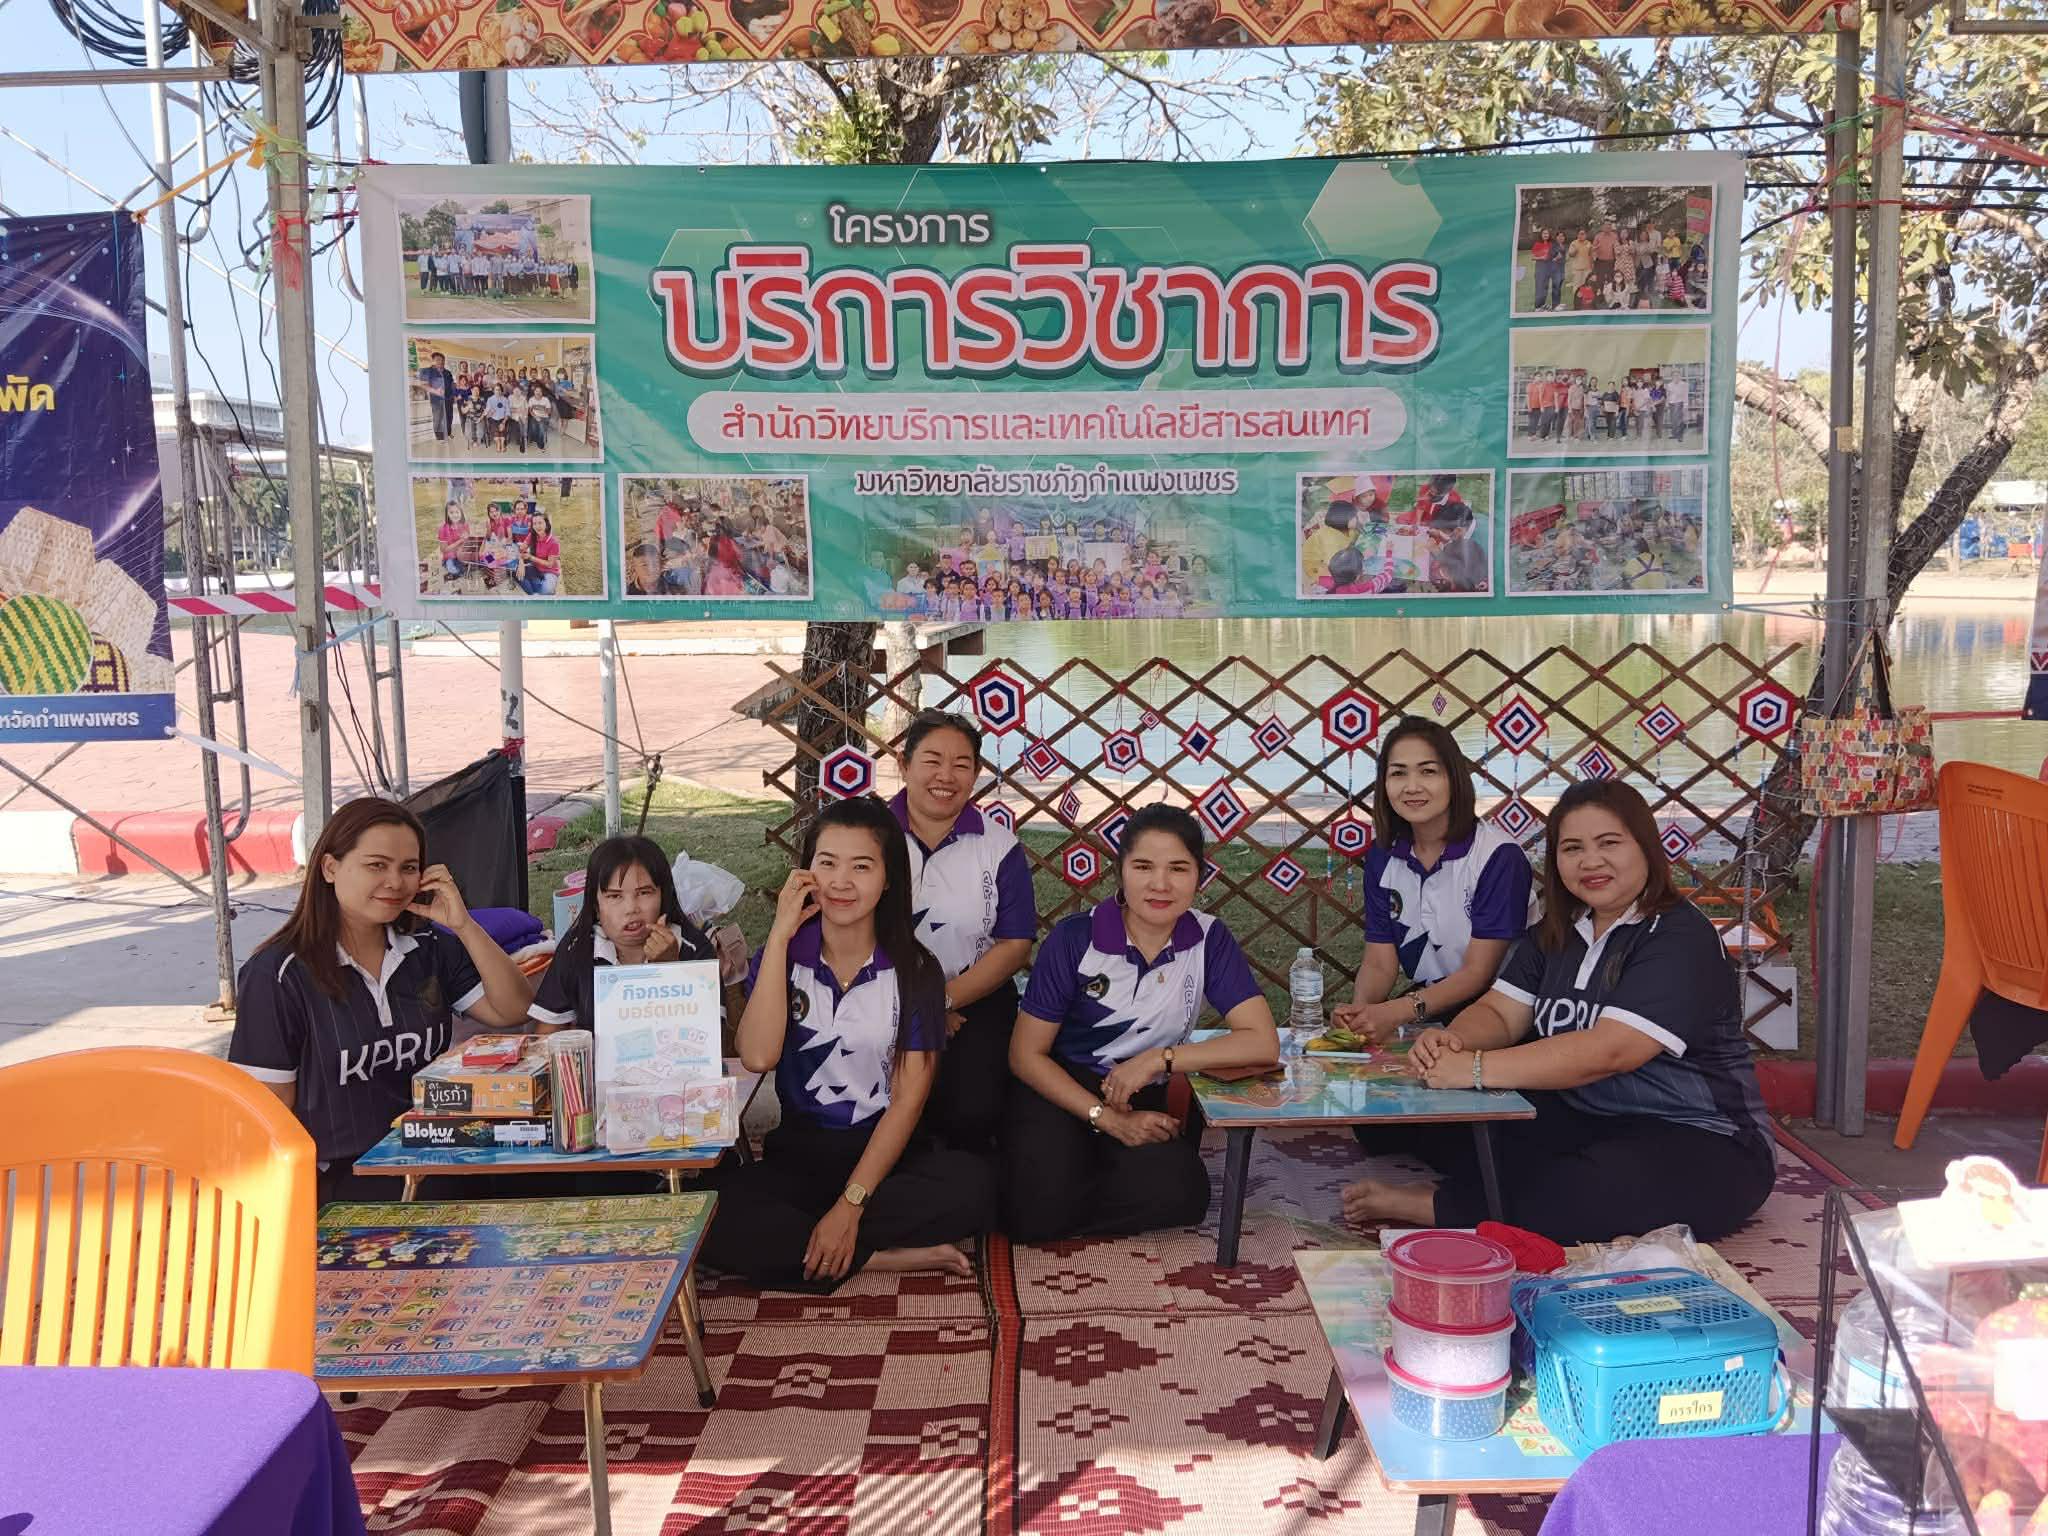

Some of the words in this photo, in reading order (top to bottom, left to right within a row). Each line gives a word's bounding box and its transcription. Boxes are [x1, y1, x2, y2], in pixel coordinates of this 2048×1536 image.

[829, 204, 991, 245] โครงการ
[653, 243, 1441, 376] บริการวิชาการ
[720, 403, 1370, 441] สำนักวิทยบริการและเทคโนโลยีสารสนเทศ
[856, 465, 1237, 499] มหาวิทยาลัยราชภัฏกำแพงเพชร
[623, 982, 694, 1001] กิจกรรม
[617, 1001, 699, 1021] บอร์ดเกม
[339, 1023, 444, 1086] KPRU
[403, 1122, 455, 1139] Blokus
